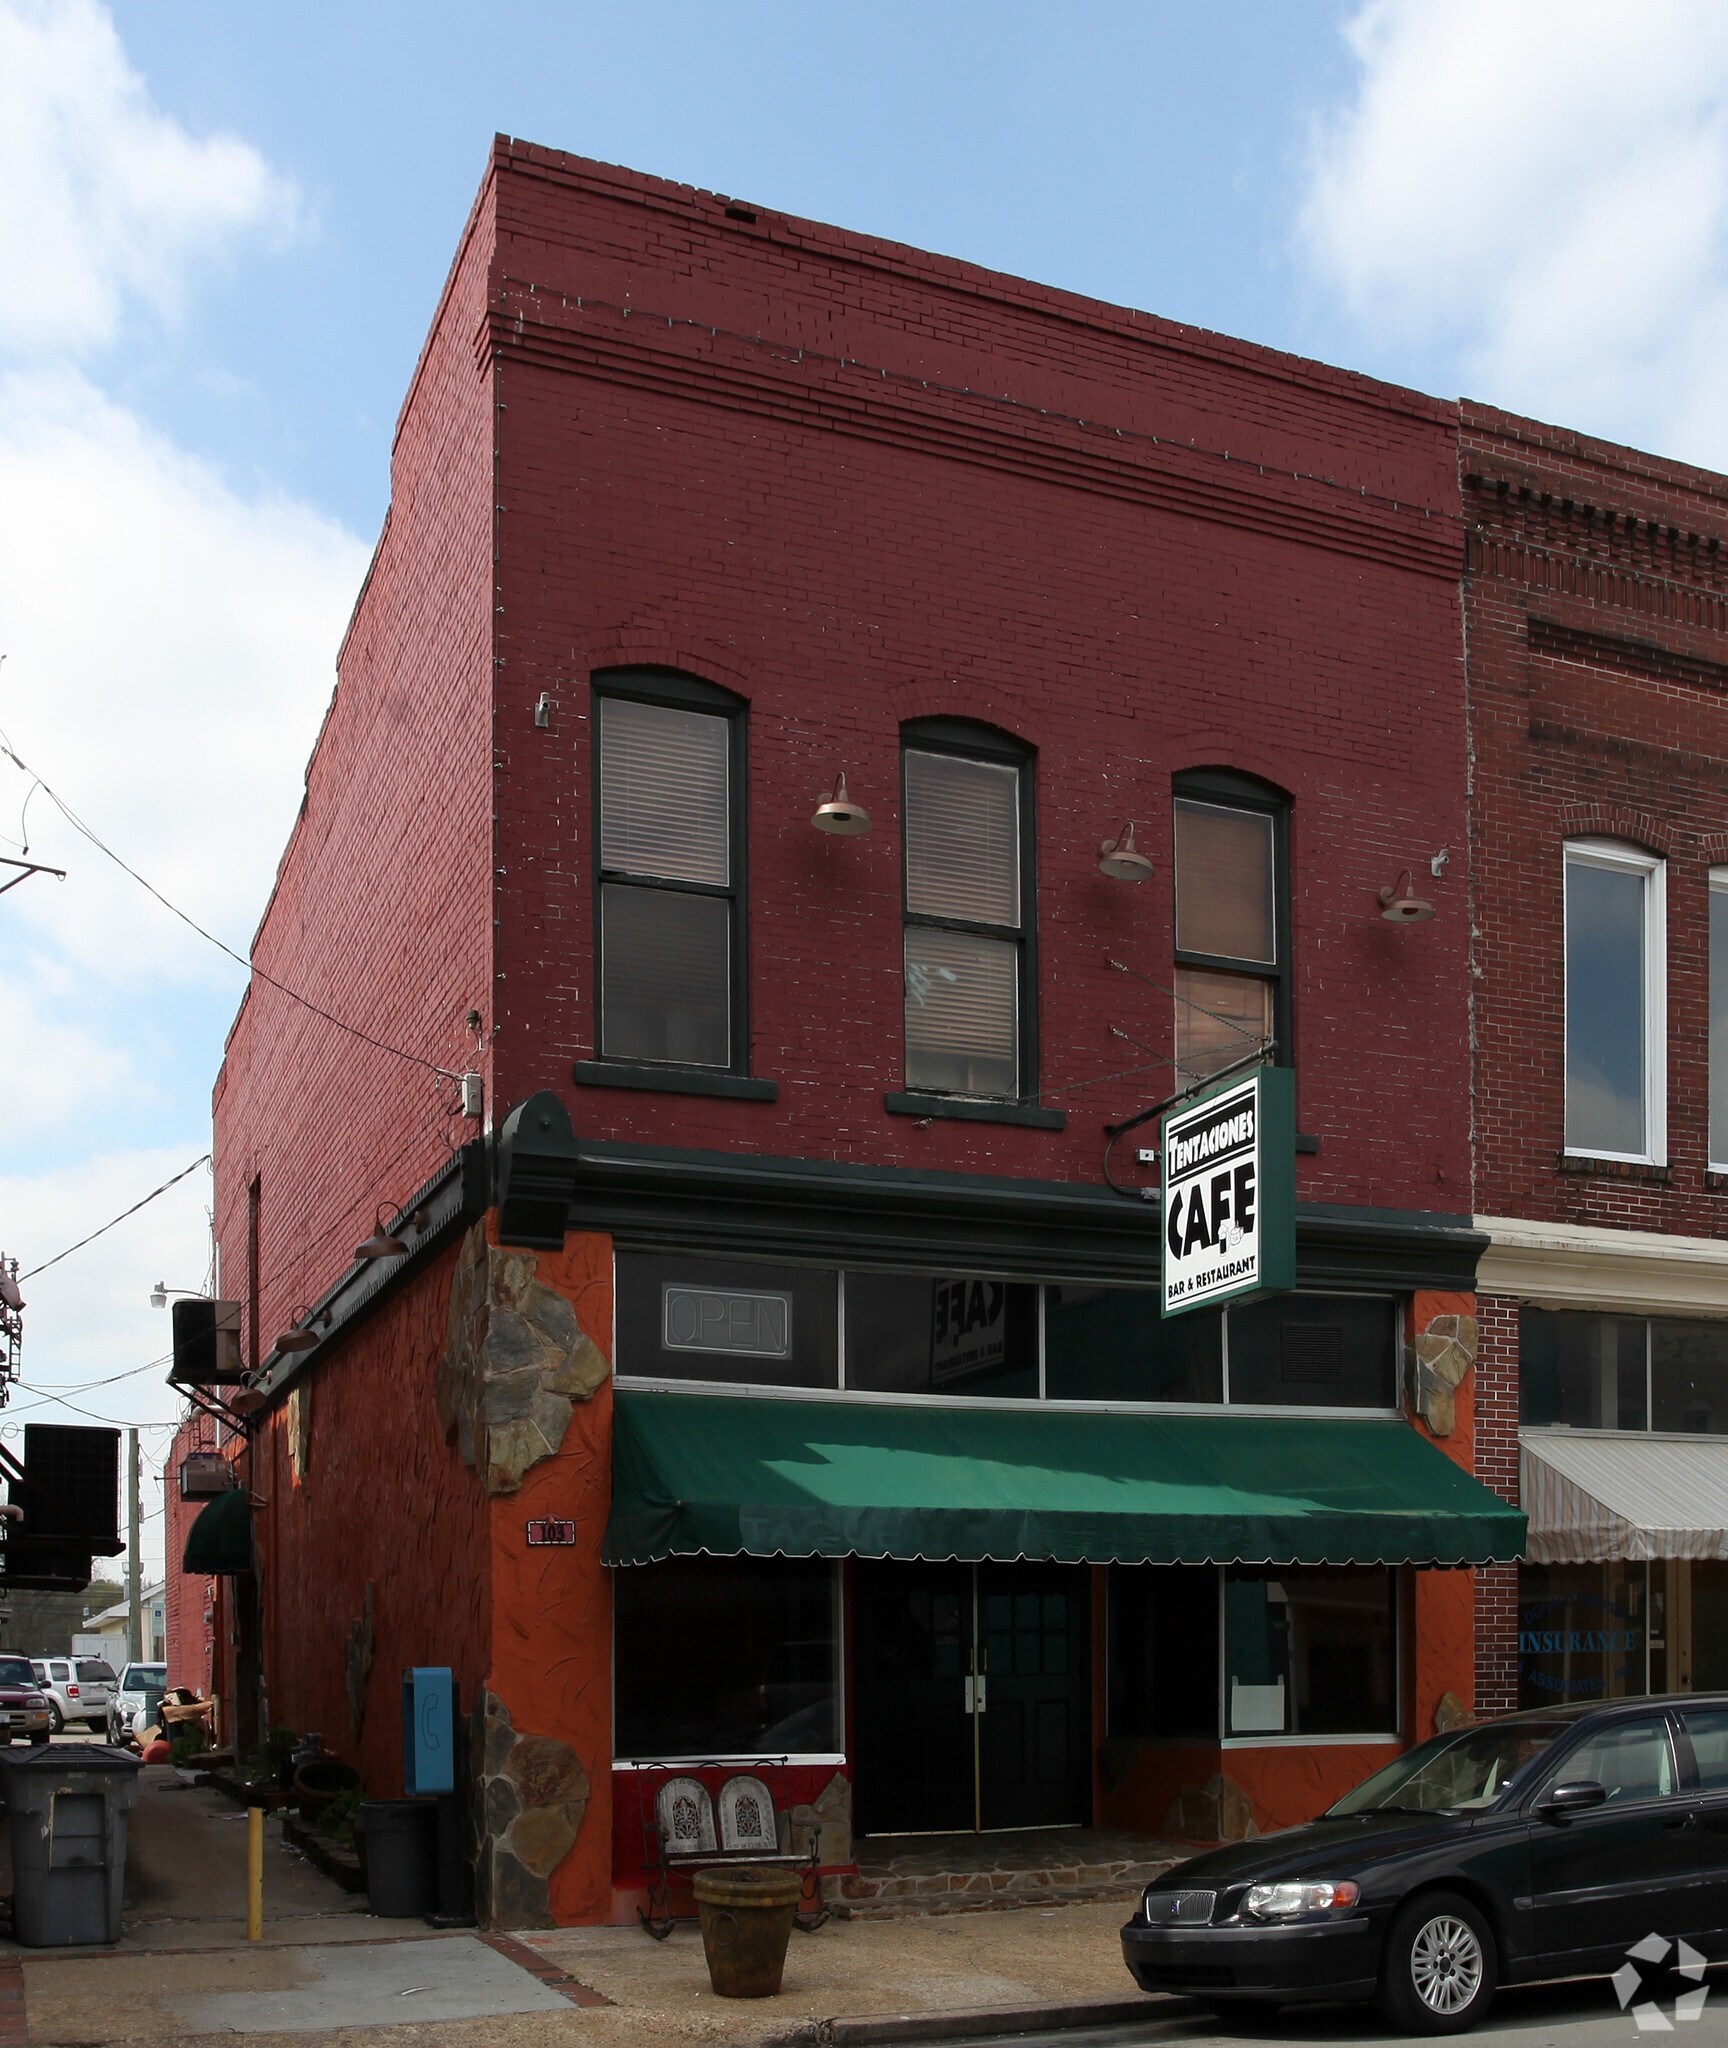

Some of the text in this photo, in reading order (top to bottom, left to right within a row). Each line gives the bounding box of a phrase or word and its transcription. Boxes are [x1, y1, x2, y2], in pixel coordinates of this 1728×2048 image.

[1168, 1110, 1254, 1177] TENTACIONES
[1167, 1161, 1255, 1261] CAFE
[1168, 1255, 1255, 1298] BAR & RESTAURANT
[671, 1295, 783, 1351] OPEN
[1519, 1631, 1636, 1654] INSURANCE
